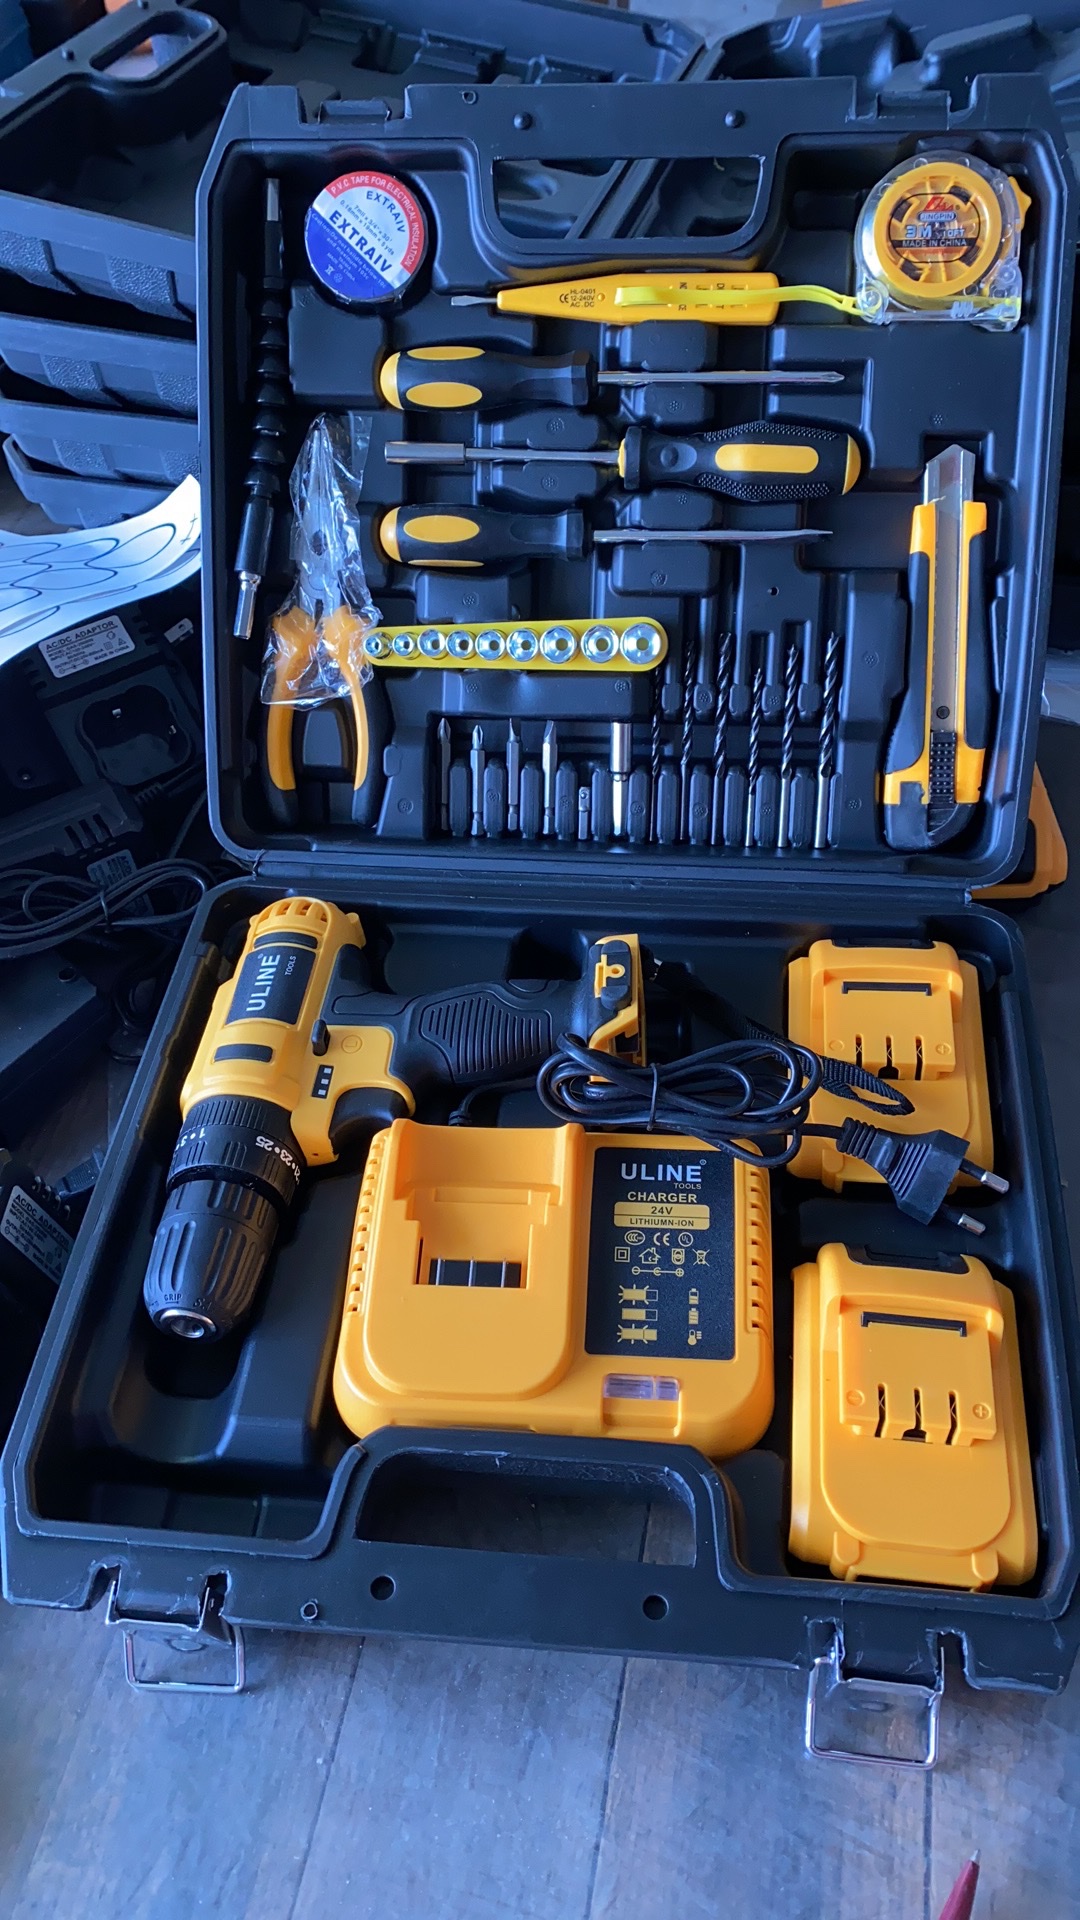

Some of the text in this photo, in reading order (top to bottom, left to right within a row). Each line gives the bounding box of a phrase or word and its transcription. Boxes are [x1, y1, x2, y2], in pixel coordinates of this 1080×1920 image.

[350, 175, 370, 184] TAPE
[371, 176, 387, 188] FOR
[386, 182, 416, 220] ELECTRICAL
[366, 190, 406, 232] EXTRAIV
[921, 212, 954, 220] JINGPIN
[329, 210, 392, 272] EXTRAIV
[940, 239, 967, 247] CHINA
[46, 636, 72, 650] AC/DC
[75, 620, 115, 639] ADAPTOR
[284, 956, 296, 976] TOOLS
[246, 954, 280, 1012] ULINE
[255, 1136, 274, 1152] 25
[621, 1163, 702, 1182] ULINE
[627, 1191, 698, 1204] CHARGER
[651, 1206, 673, 1215] 24V
[630, 1218, 694, 1227] LITHIUMN-ION
